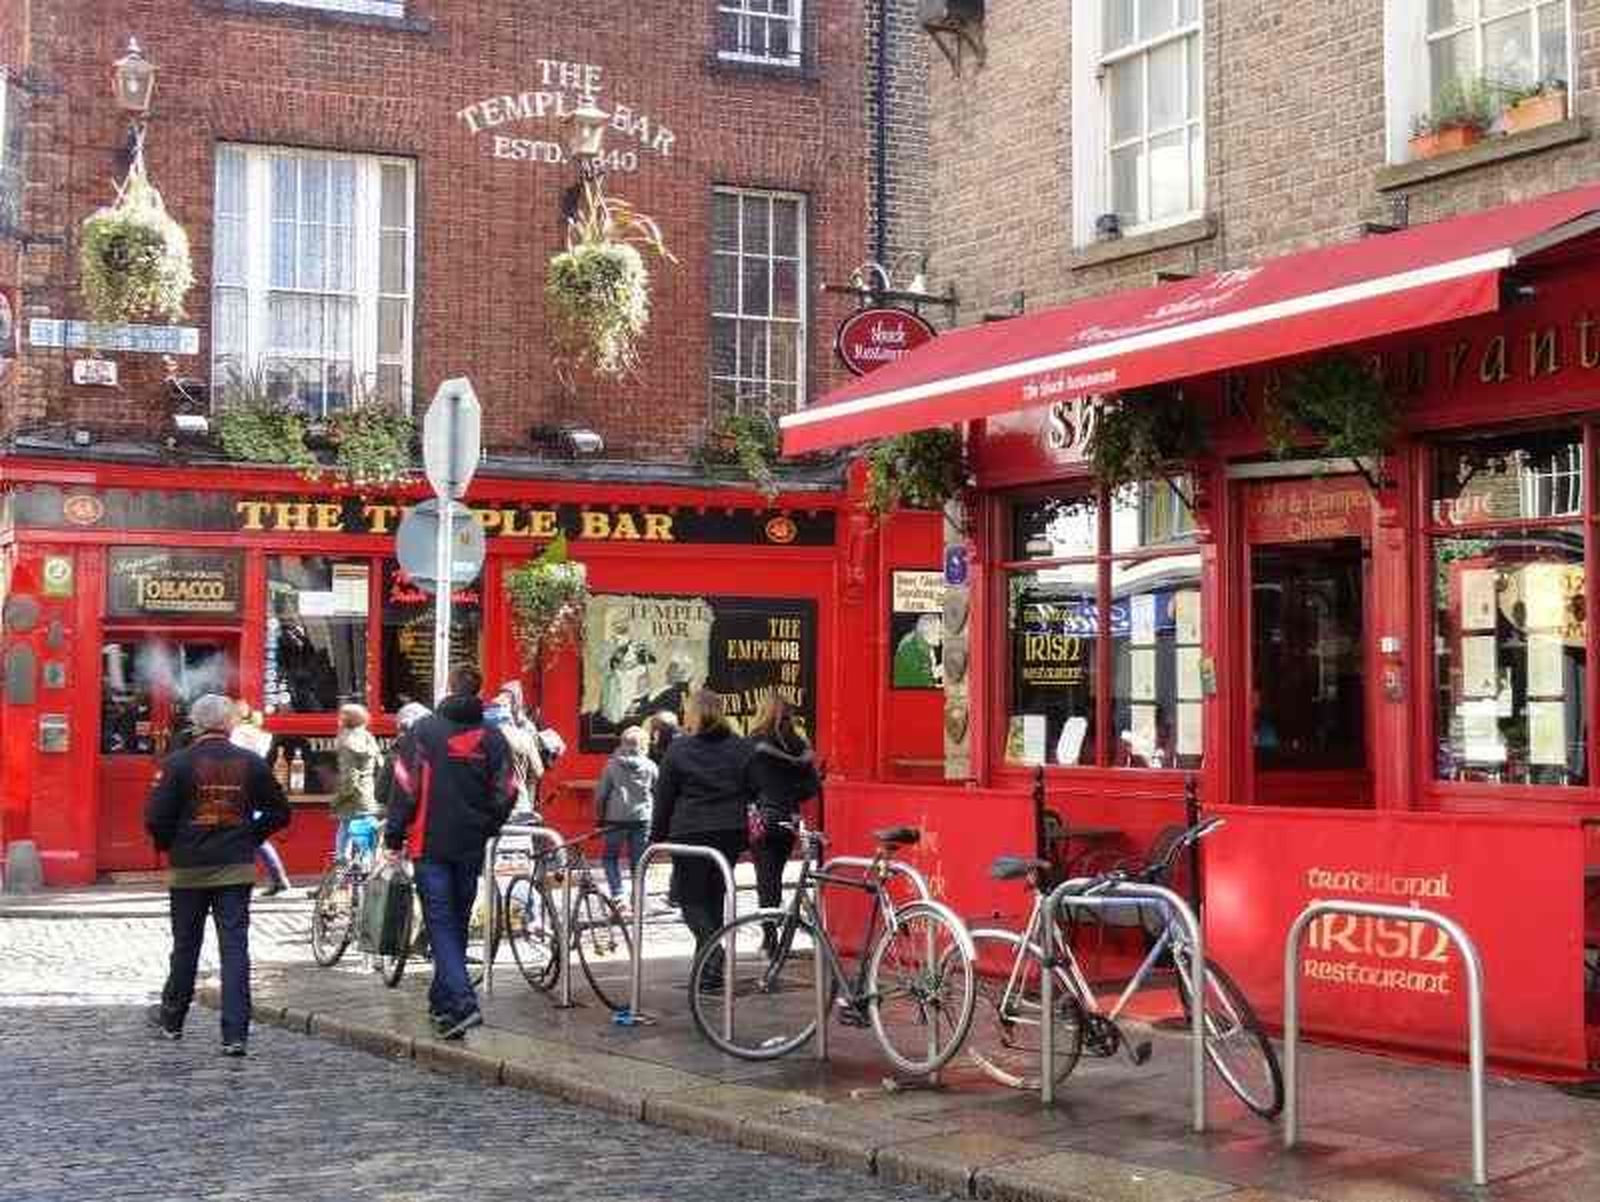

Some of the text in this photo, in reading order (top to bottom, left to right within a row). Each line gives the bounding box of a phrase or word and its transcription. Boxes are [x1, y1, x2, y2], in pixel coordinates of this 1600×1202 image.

[537, 59, 603, 95] THE
[609, 103, 677, 156] BAR
[591, 147, 638, 172] 840
[237, 500, 675, 541] THE TPLE BAR
[136, 575, 225, 606] TOBACCO
[767, 617, 801, 638] THE
[726, 639, 801, 662] EMPEROR
[780, 663, 801, 684] OF
